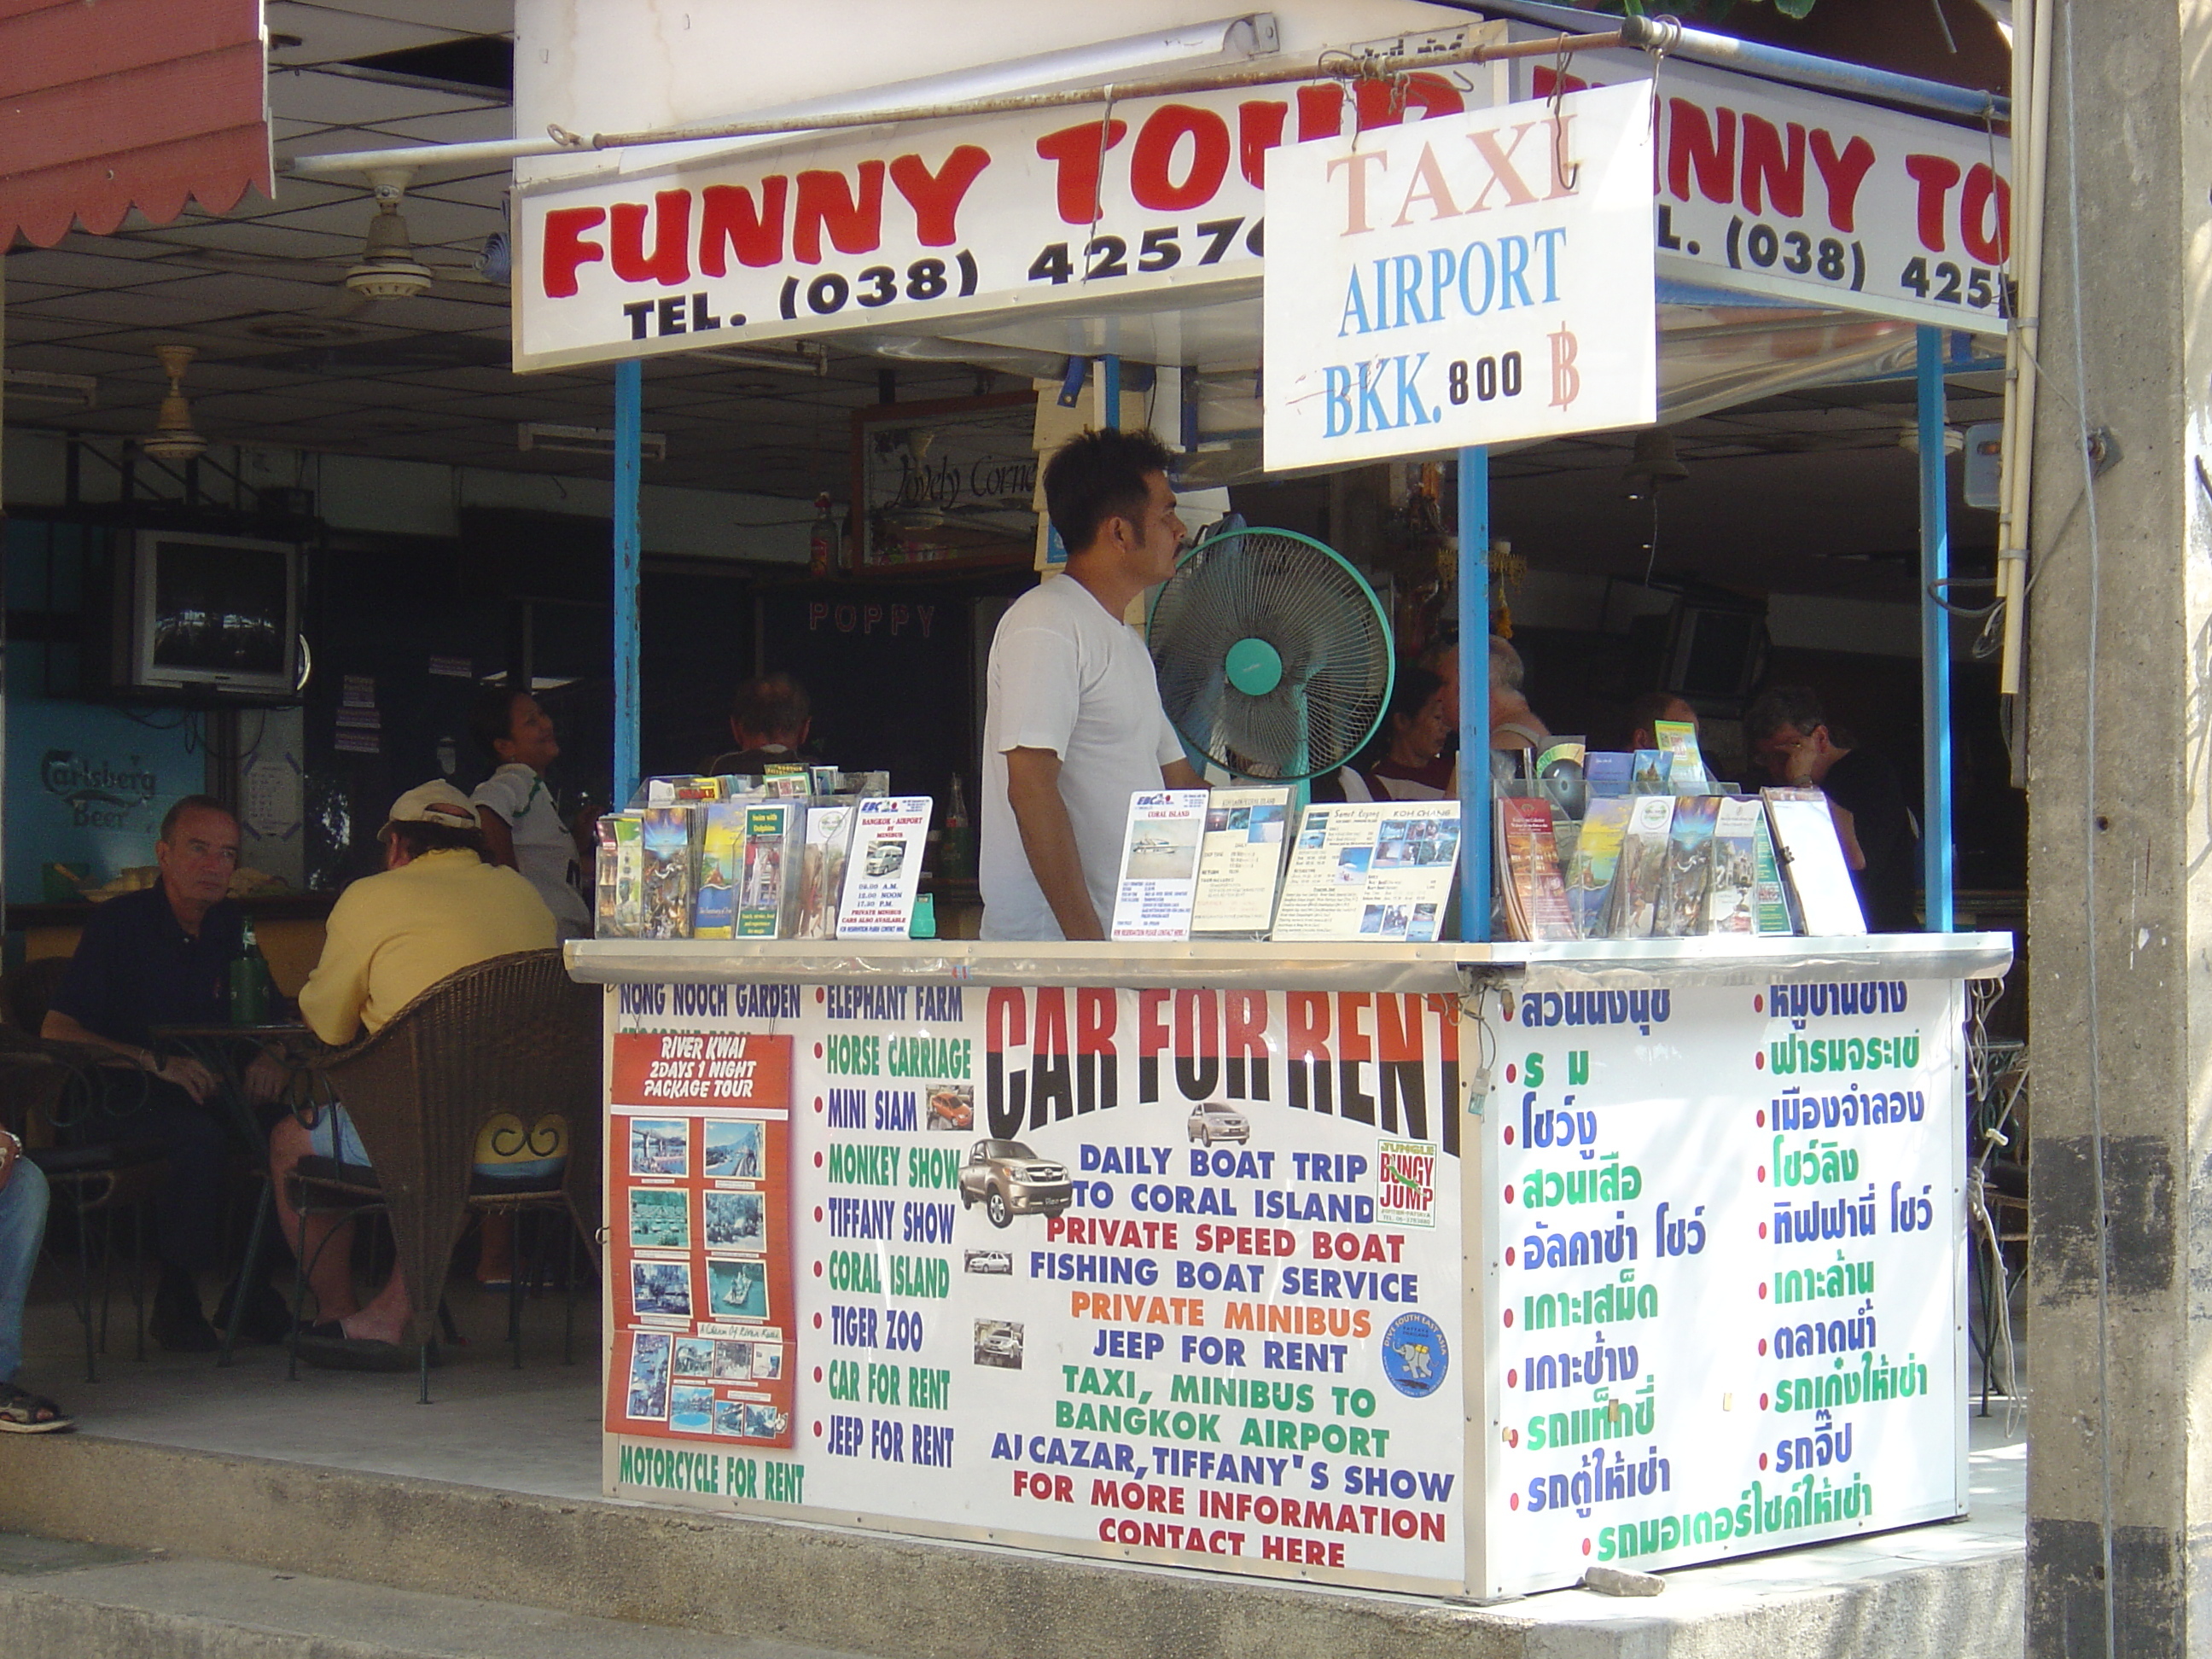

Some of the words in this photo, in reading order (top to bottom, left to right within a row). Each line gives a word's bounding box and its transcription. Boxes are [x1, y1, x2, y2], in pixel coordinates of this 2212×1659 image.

[1327, 114, 1580, 237] TAXI
[543, 144, 991, 299] FUNNY
[1726, 216, 1865, 291] (038)
[624, 292, 746, 340] TEL.
[779, 248, 978, 319] (038)
[1337, 227, 1566, 337] AIRPORT
[1322, 352, 1441, 439] BKK.
[1449, 351, 1522, 405] 800
[811, 602, 934, 637] POPPY
[41, 749, 156, 800] Carlsberg
[73, 800, 130, 827] Beer
[620, 984, 666, 1015] NONG
[673, 984, 727, 1016] NOOCH
[736, 984, 800, 1018] GARDEN
[827, 986, 907, 1021] ELEPHANT
[915, 987, 963, 1022] FARM
[650, 1061, 696, 1078] 2DAYS
[698, 1061, 706, 1078] 1
[708, 1061, 757, 1078] NIGHT
[661, 1036, 703, 1059] RIVER
[706, 1037, 746, 1060] KWAI
[827, 1034, 880, 1076] HORSE
[888, 1035, 971, 1080] CARRIAGE
[986, 987, 1118, 1139] CAR
[1138, 989, 1270, 1103] FOR
[1286, 992, 1461, 1158] RENT
[644, 1080, 710, 1098] PACKAGE
[713, 1080, 753, 1097] TOUR
[828, 1088, 866, 1130] MINI
[876, 1090, 917, 1131] SIAM
[1772, 1083, 1924, 1132] เมืองจำลอง
[828, 1144, 900, 1185] MONKEY
[909, 1148, 961, 1190] SHOW
[1080, 1144, 1173, 1176] DAILY
[1194, 1150, 1276, 1180] BOAT
[1292, 1153, 1367, 1184] TRIP
[1380, 1152, 1435, 1187] BUNGY
[1381, 1143, 1435, 1155] JUNGLE
[1773, 1134, 1859, 1187] โชว์ลิง
[1072, 1179, 1115, 1210] TO
[1131, 1184, 1237, 1216] CORAL
[1254, 1190, 1374, 1225] ISLAND
[1380, 1184, 1434, 1211] JUMP
[1523, 1151, 1642, 1209] สวนเสือ
[828, 1197, 894, 1240] TIFFANY
[904, 1201, 955, 1243] SHOW
[1524, 1210, 1638, 1270] อัลคาซ่า
[1656, 1202, 1706, 1258] โชว์
[1774, 1183, 1876, 1244] ทิฟฟานี่
[1891, 1181, 1933, 1233] โชว์
[1046, 1216, 1178, 1249] PRIVATE
[1196, 1224, 1295, 1258] SPEED
[1313, 1231, 1405, 1263] BOAT
[829, 1250, 882, 1292] CORAL
[890, 1254, 950, 1299] ISLAND
[1030, 1251, 1159, 1285] FISHING
[1177, 1260, 1264, 1291] BOAT
[1282, 1266, 1418, 1303] SERVICE
[1524, 1268, 1658, 1330] เกาะเสม็ด
[1774, 1249, 1874, 1304] เกาะล้าน
[831, 1306, 877, 1348] TIGER
[886, 1309, 923, 1353] ZOO
[1071, 1291, 1204, 1326] PRIVATE
[1224, 1301, 1372, 1338] MINIBUS
[1383, 1326, 1396, 1348] DIVE
[1394, 1314, 1420, 1328] SOUTH
[1421, 1317, 1440, 1333] EAST
[1436, 1334, 1447, 1356] ASIA
[1774, 1298, 1876, 1359] ตลาดน้ำ
[1093, 1330, 1164, 1360] JEEP
[1181, 1336, 1246, 1366] FOR
[1264, 1341, 1348, 1373] RENT
[1525, 1330, 1639, 1392] เกาะช้าง
[828, 1359, 859, 1401] CAR
[868, 1362, 900, 1406] FOR
[908, 1367, 950, 1411] RENT
[1062, 1365, 1153, 1405] TAXI,
[1170, 1375, 1314, 1413] MINIBUS
[1331, 1387, 1377, 1417] TO
[1774, 1351, 1927, 1413] รถเก๋งให้เช่า
[1056, 1400, 1221, 1442] BANGKOK
[1240, 1417, 1390, 1458] AIRPORT
[1527, 1374, 1655, 1451] รถแท็กซี่
[827, 1414, 864, 1457] JEEP
[871, 1419, 904, 1464] FOR
[912, 1424, 954, 1469] RENT
[1776, 1409, 1852, 1473] รถจี๊ป
[620, 1445, 719, 1493] MOTORCYCLE
[726, 1457, 757, 1499] FOR
[765, 1462, 805, 1505] RENT
[1344, 1464, 1455, 1503] SHOW
[1527, 1446, 1670, 1518] รถตู้ให้เช่า
[1013, 1470, 1074, 1504] FOR
[1091, 1479, 1185, 1516] MORE
[1199, 1492, 1446, 1543] INFORMATION
[1098, 1518, 1245, 1555] CONTACT
[1263, 1536, 1345, 1568] HERE
